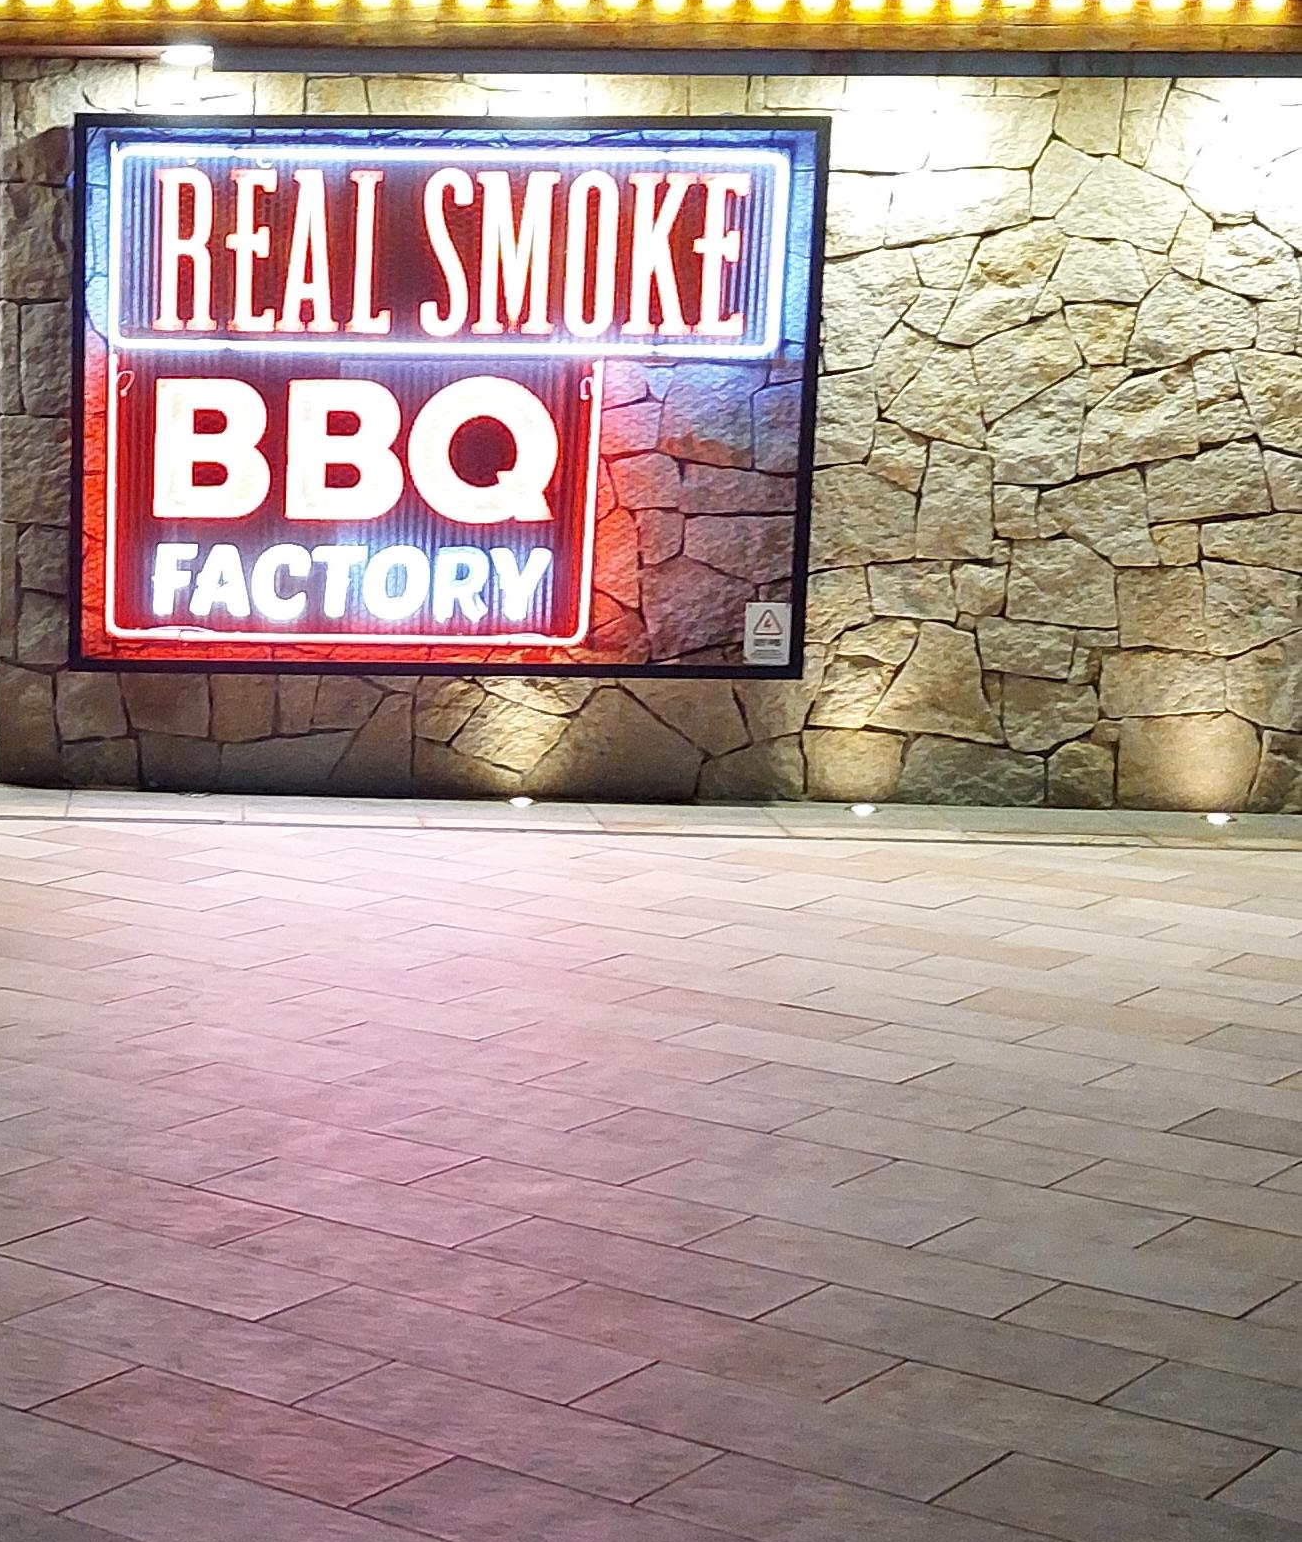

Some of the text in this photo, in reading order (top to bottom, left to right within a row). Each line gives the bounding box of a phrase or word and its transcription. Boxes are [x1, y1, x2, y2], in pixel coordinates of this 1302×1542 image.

[154, 163, 754, 338] REAL SMOKE
[151, 375, 559, 524] BBQ
[150, 542, 553, 623] FACTORY
